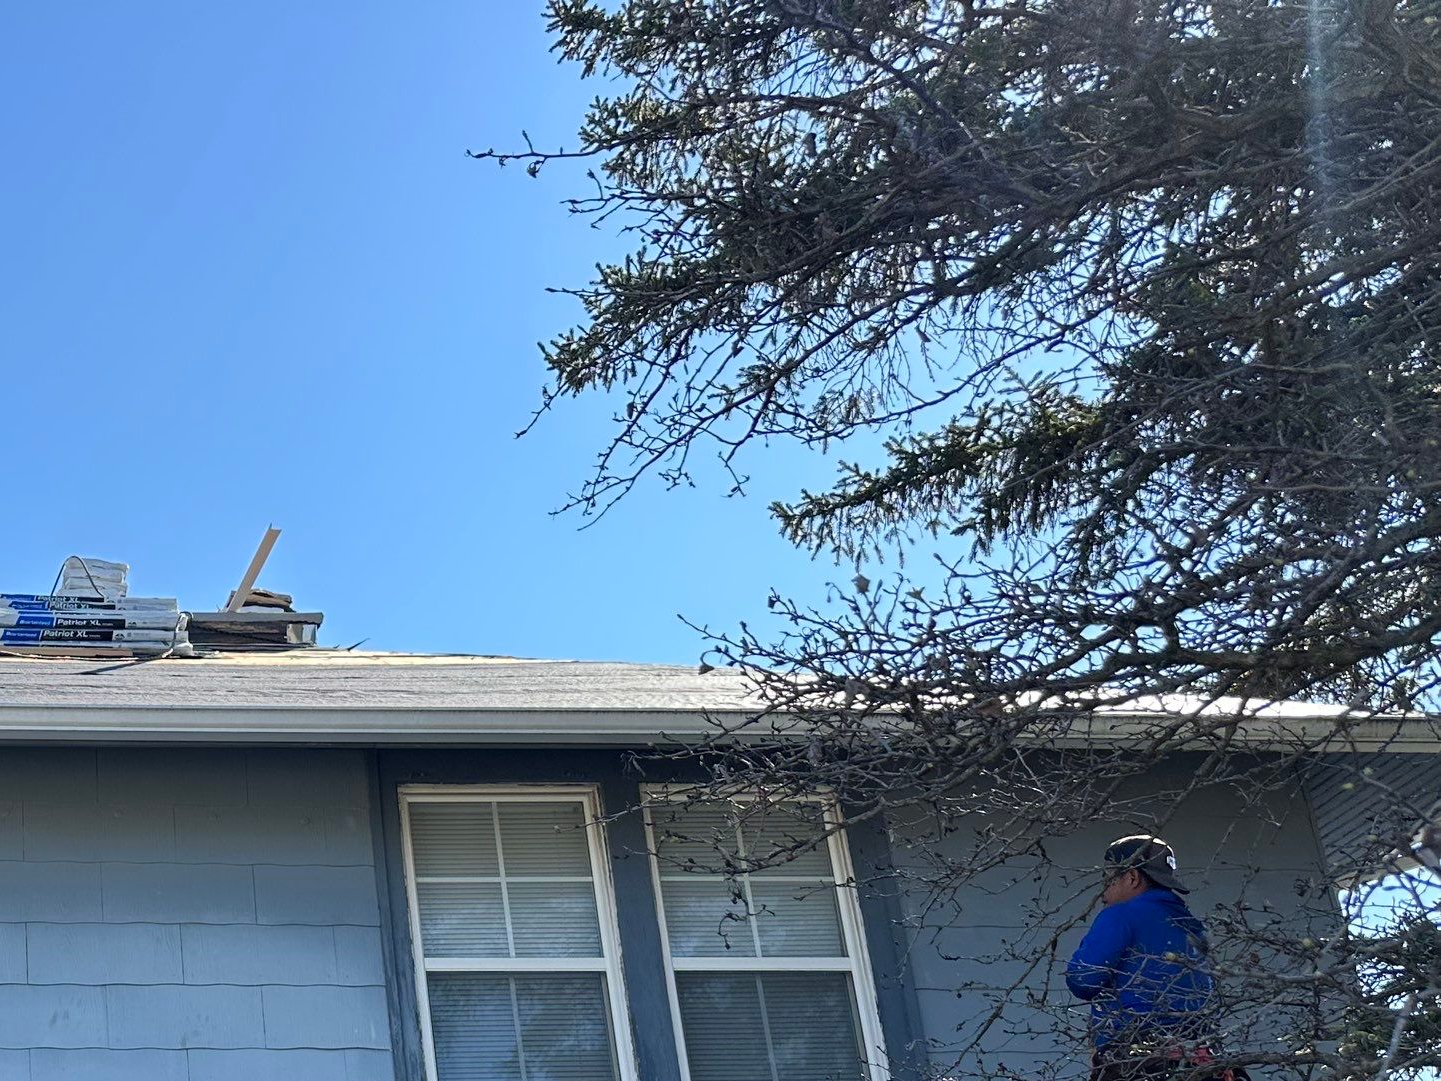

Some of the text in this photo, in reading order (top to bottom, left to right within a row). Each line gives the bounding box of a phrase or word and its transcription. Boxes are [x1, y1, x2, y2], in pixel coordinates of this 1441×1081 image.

[57, 618, 87, 627] Patriot
[43, 630, 75, 638] Patriot
[76, 630, 89, 638] XL
